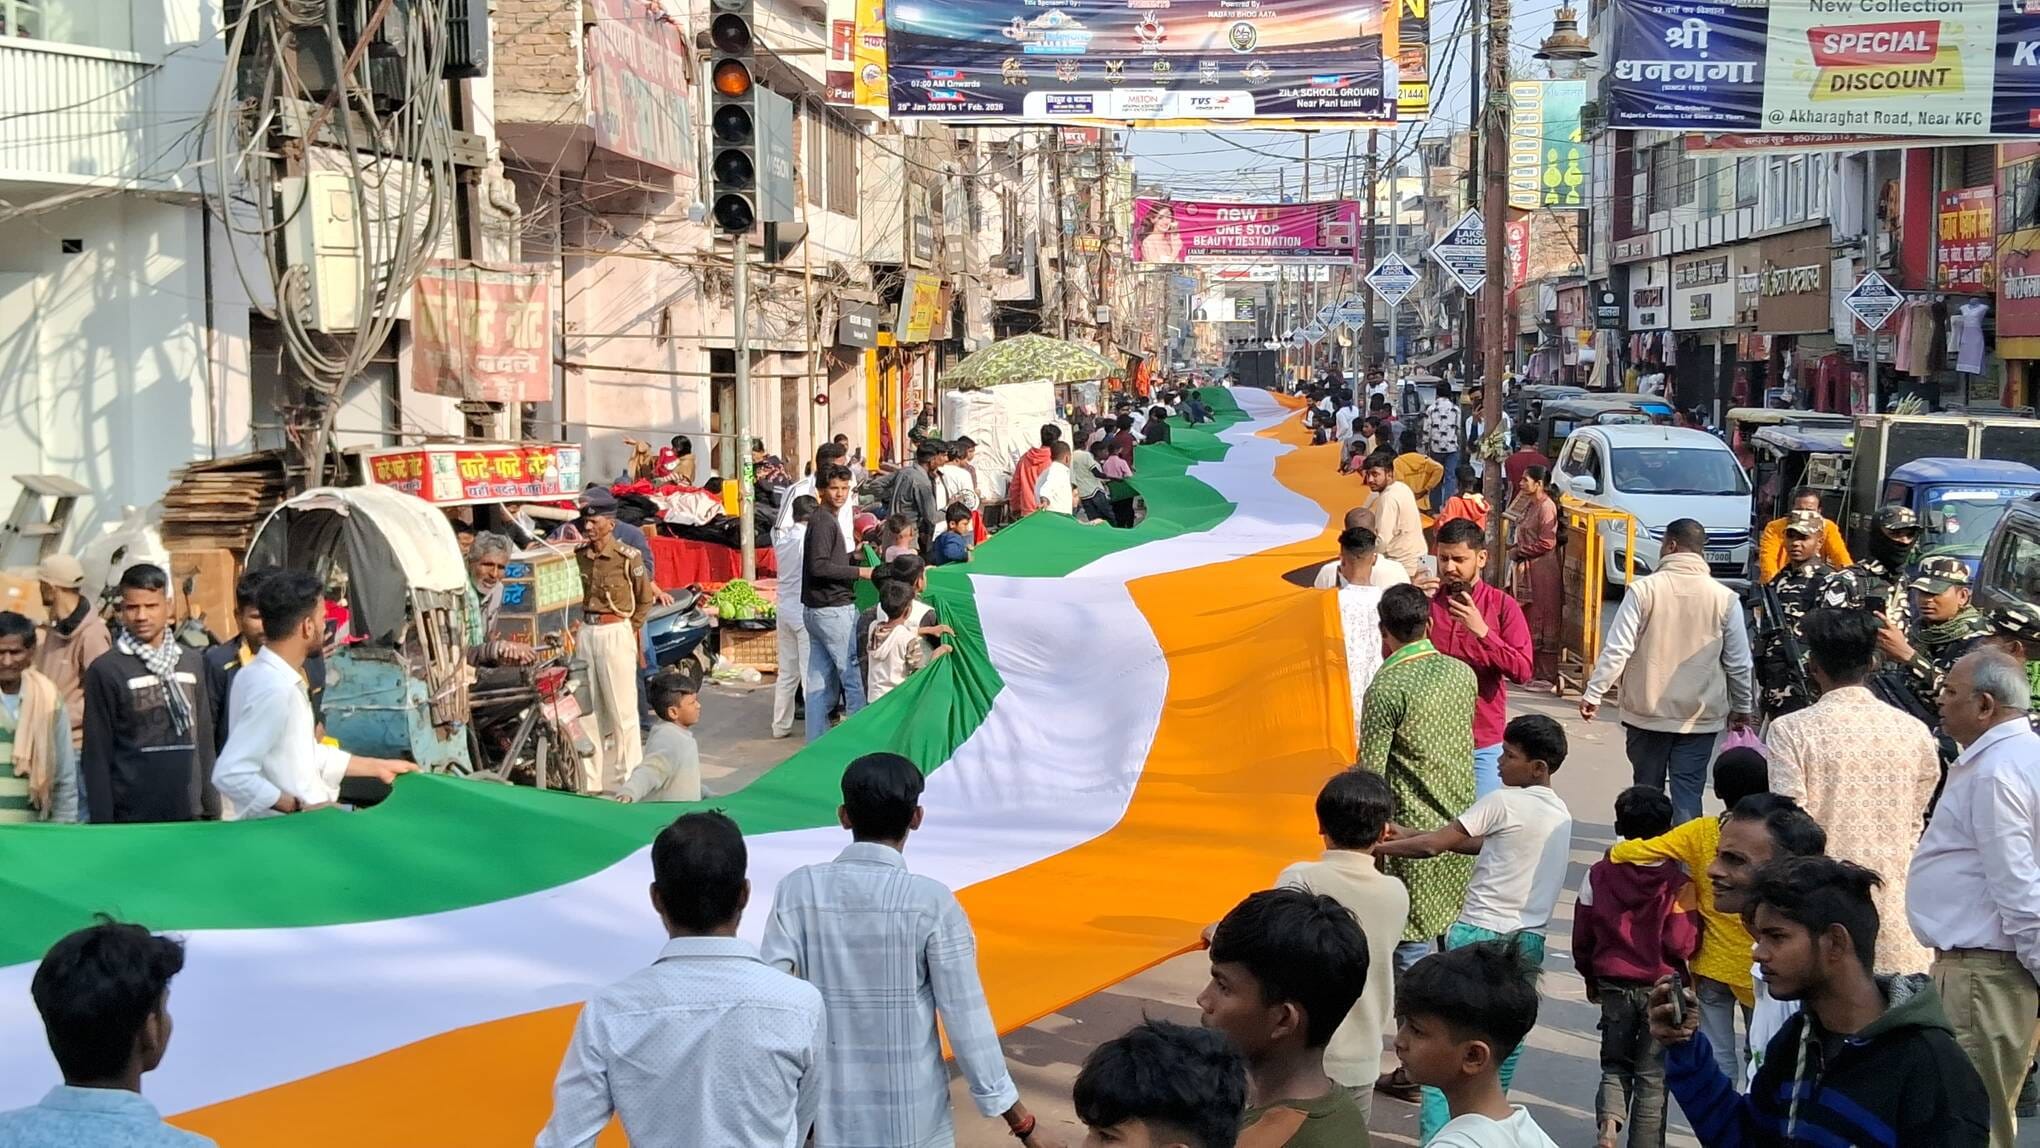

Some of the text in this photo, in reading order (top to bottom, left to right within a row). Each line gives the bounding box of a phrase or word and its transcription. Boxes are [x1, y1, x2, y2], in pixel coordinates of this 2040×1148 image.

[1809, 0, 1964, 13] New Collection
[1665, 18, 1712, 49] श्री
[1822, 31, 1931, 55] SPECIAL
[1615, 51, 1758, 83] धनगंगा
[947, 80, 981, 88] Onwards
[1830, 67, 1951, 92] DISCOUNT
[1279, 88, 1380, 97] ZILA SCHOOL GROUND
[1128, 96, 1158, 104] MILTON
[1297, 100, 1318, 108] Near
[912, 103, 926, 111] Jan
[947, 103, 957, 111] To
[1768, 109, 1983, 127] @ Akharaghat Road, Near KFC
[1216, 208, 1258, 221] new
[1216, 224, 1281, 235] ONE STOP
[1456, 230, 1484, 238] LAKS
[1193, 236, 1302, 247] BEAUTY DESTINATION
[1454, 238, 1487, 246] SCHOO
[459, 452, 523, 481] कटे-फटे
